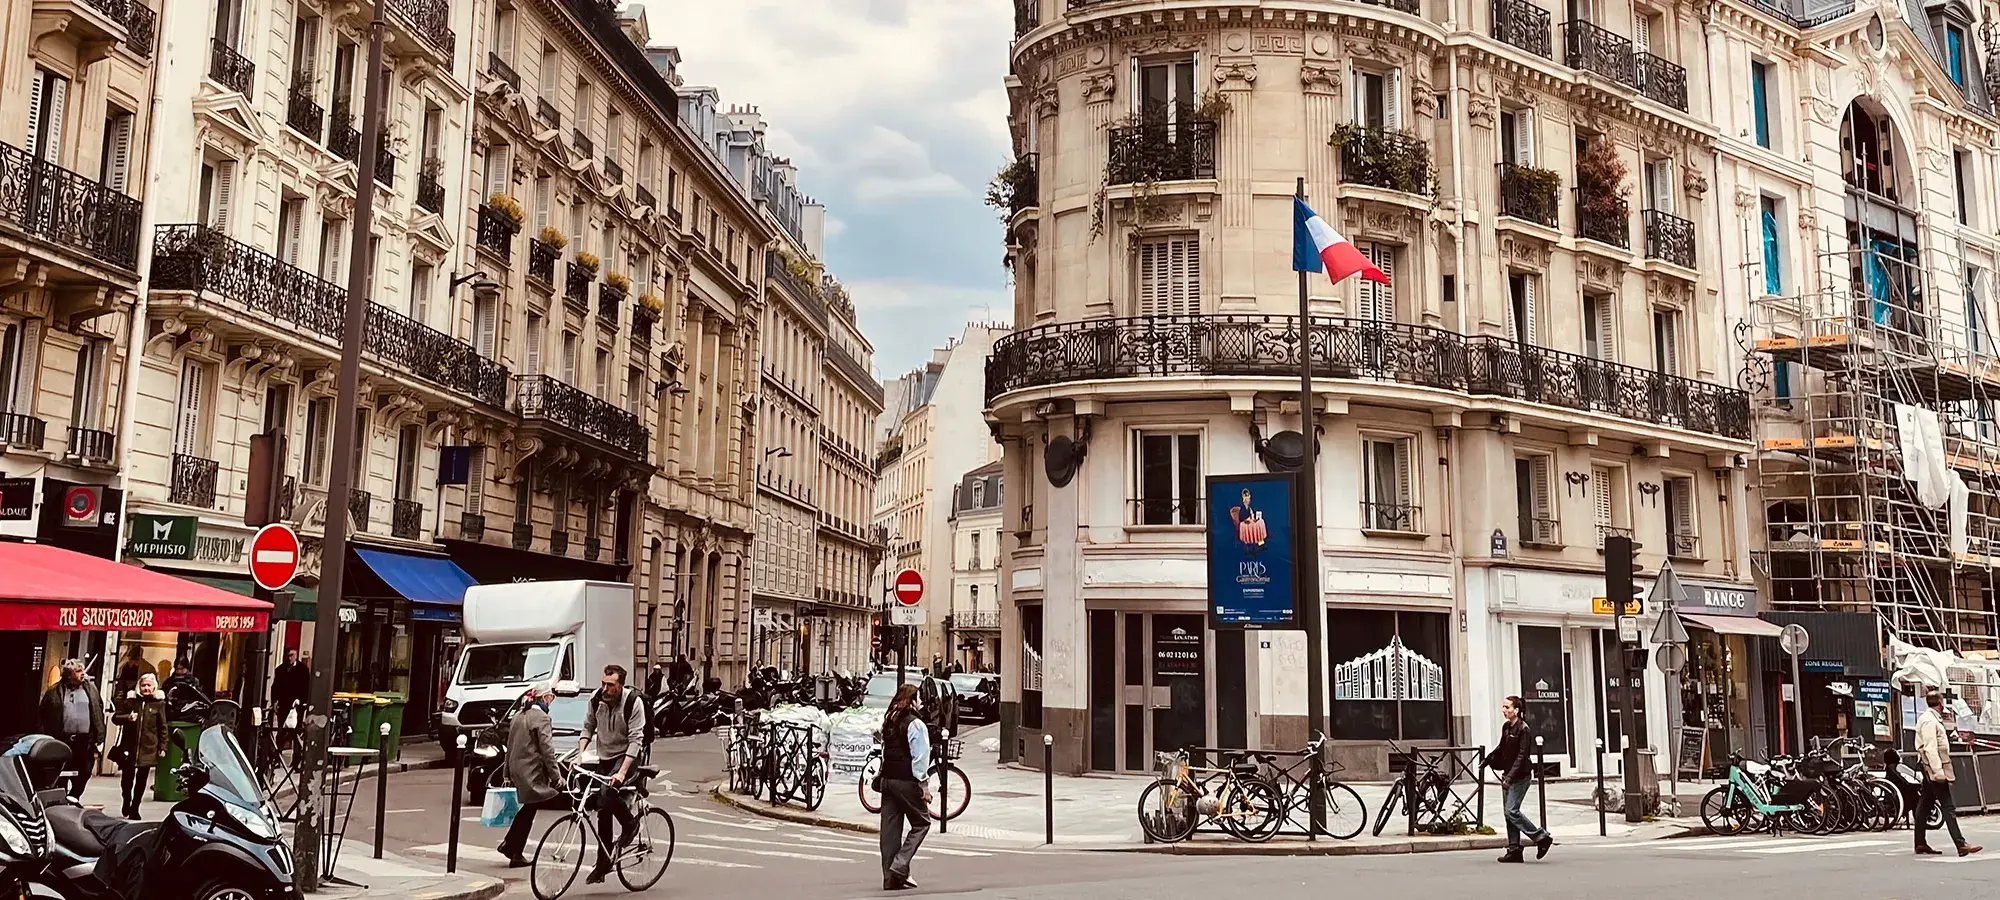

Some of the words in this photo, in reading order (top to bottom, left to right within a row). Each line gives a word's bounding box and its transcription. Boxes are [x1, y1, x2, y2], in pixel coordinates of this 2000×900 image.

[133, 543, 186, 555] MEPHISTO
[1239, 561, 1266, 578] PARIS
[59, 607, 78, 627] AU
[81, 607, 153, 627] SAUVIGNON
[215, 615, 239, 629] DEPUIS
[239, 615, 255, 629] 1954
[1158, 651, 1166, 659] 06
